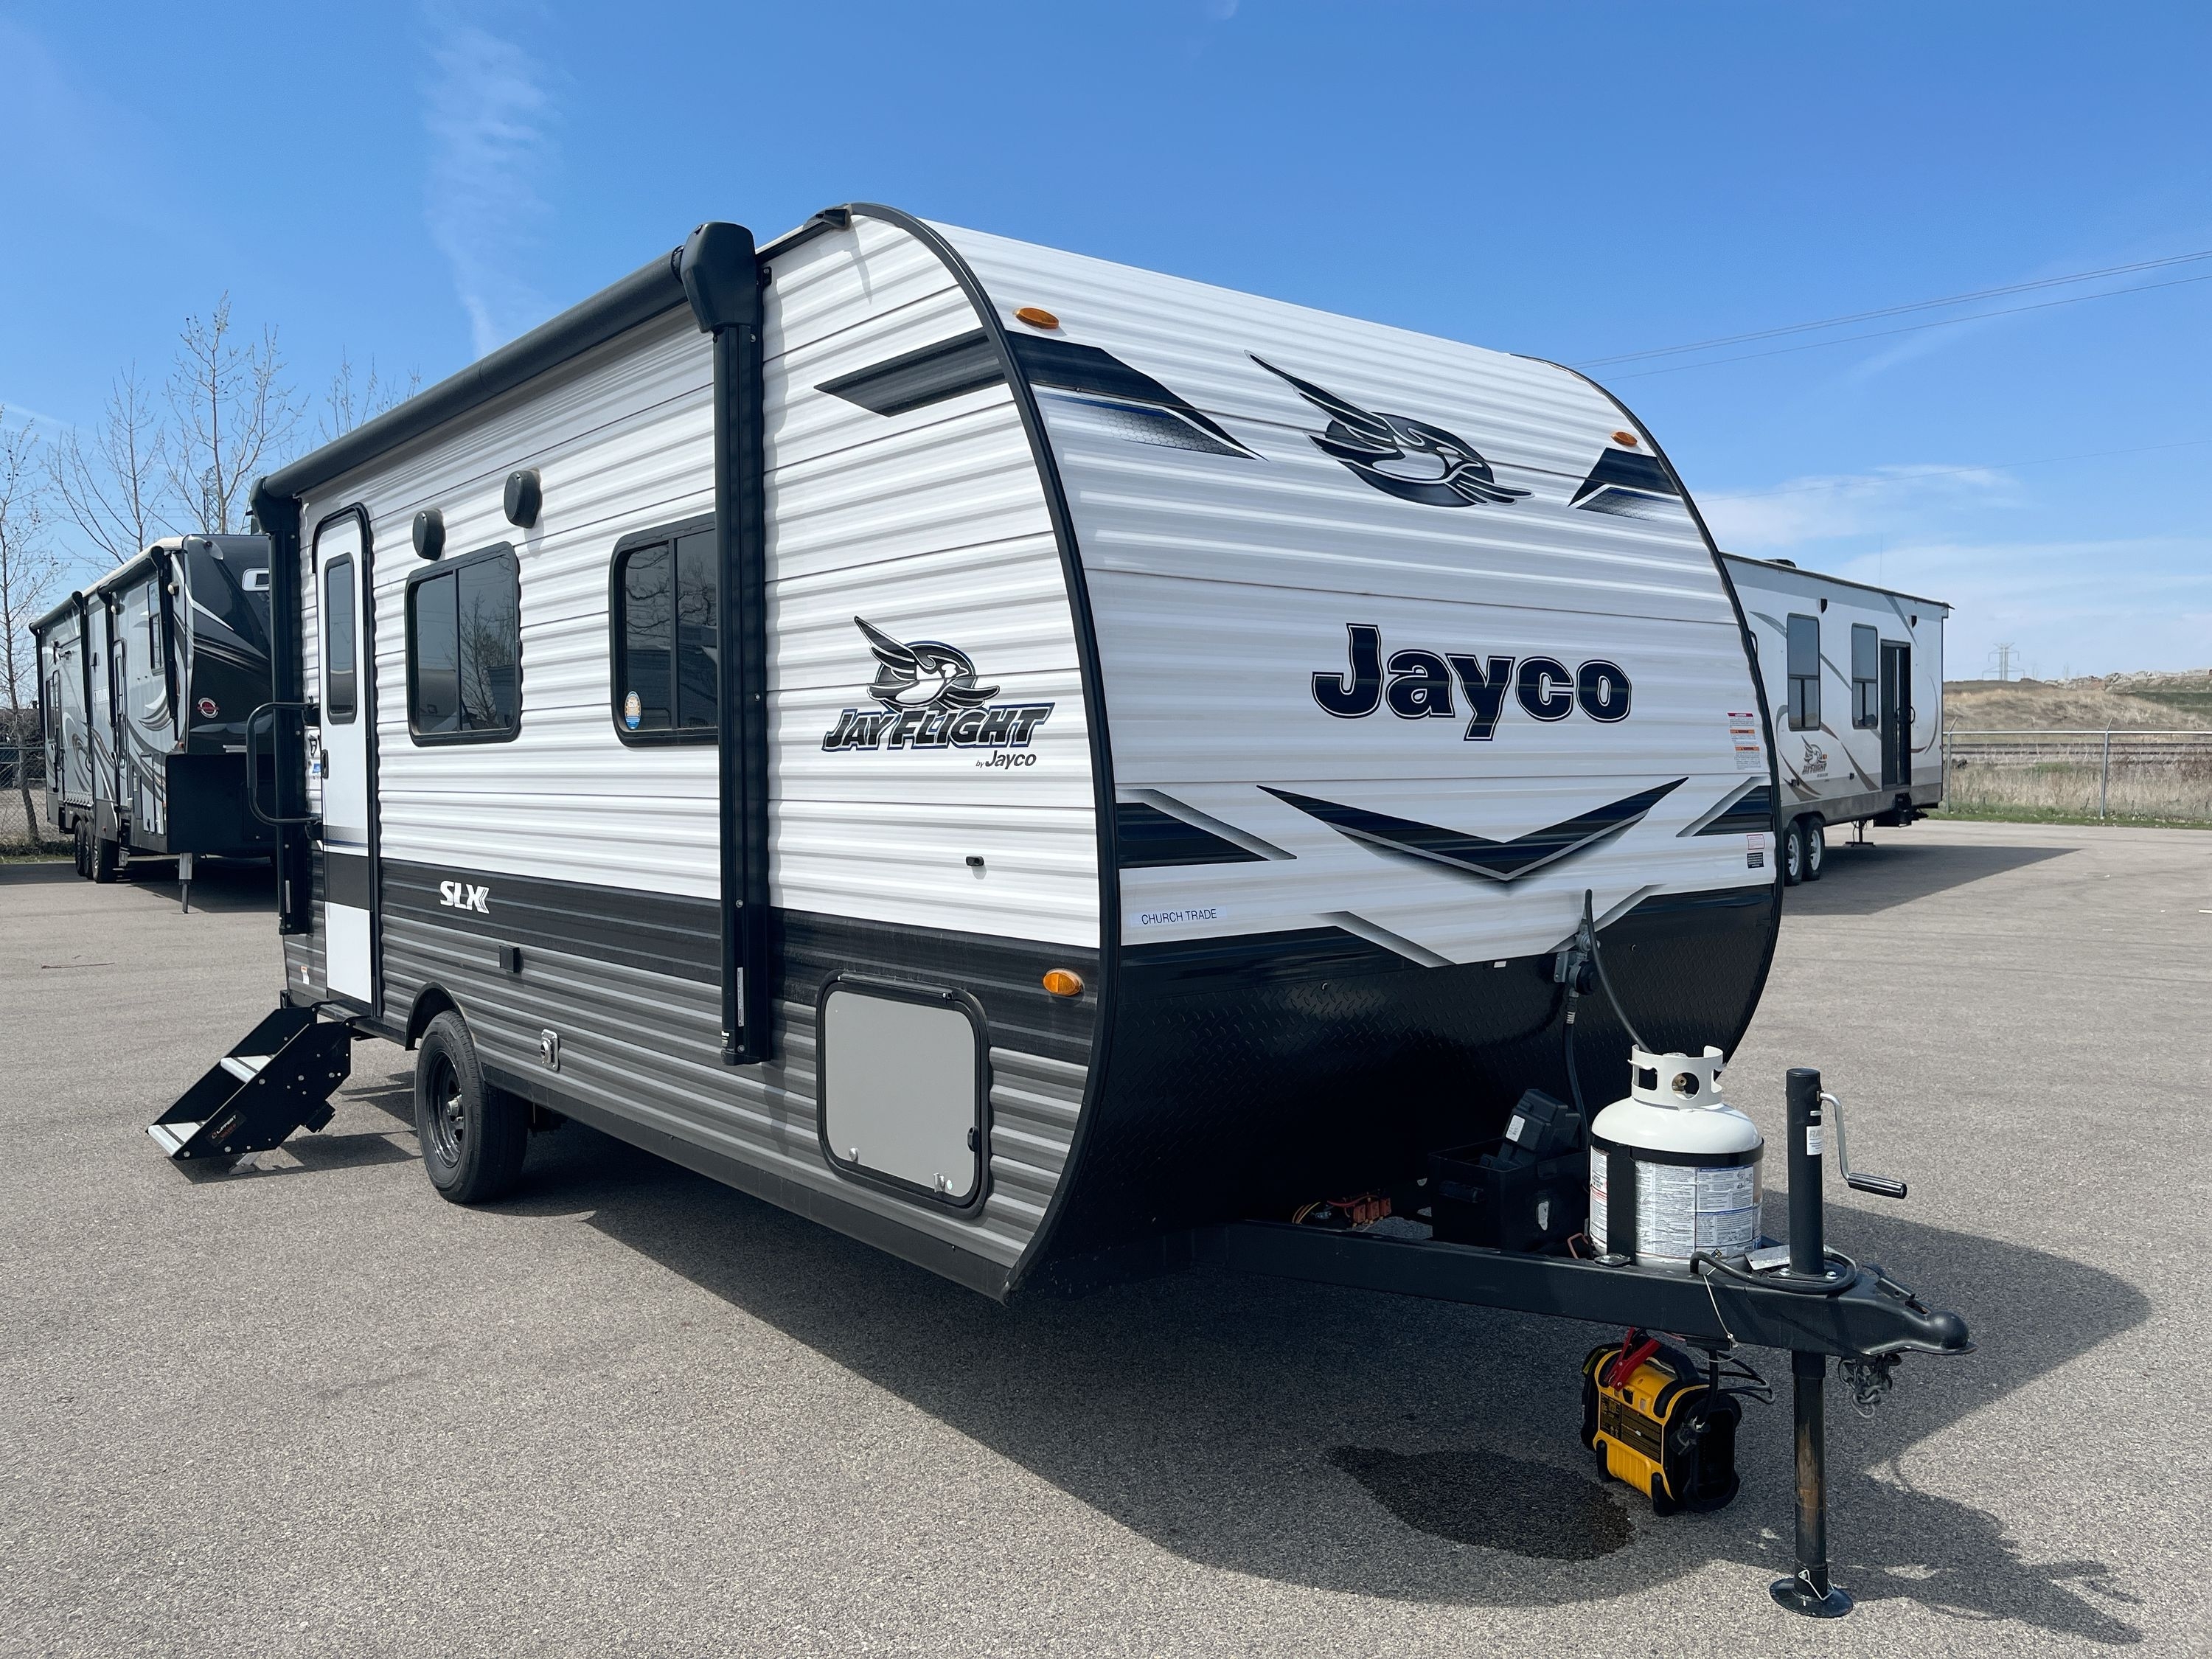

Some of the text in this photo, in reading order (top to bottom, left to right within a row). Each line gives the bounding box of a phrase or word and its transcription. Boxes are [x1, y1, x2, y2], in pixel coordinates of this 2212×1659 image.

[1312, 623, 1632, 741] Jayco
[975, 750, 1037, 769] by Jayco
[439, 880, 490, 914] SLX
[1141, 908, 1217, 925] CHURCH TRADE
[1809, 1130, 1822, 1138] RA
